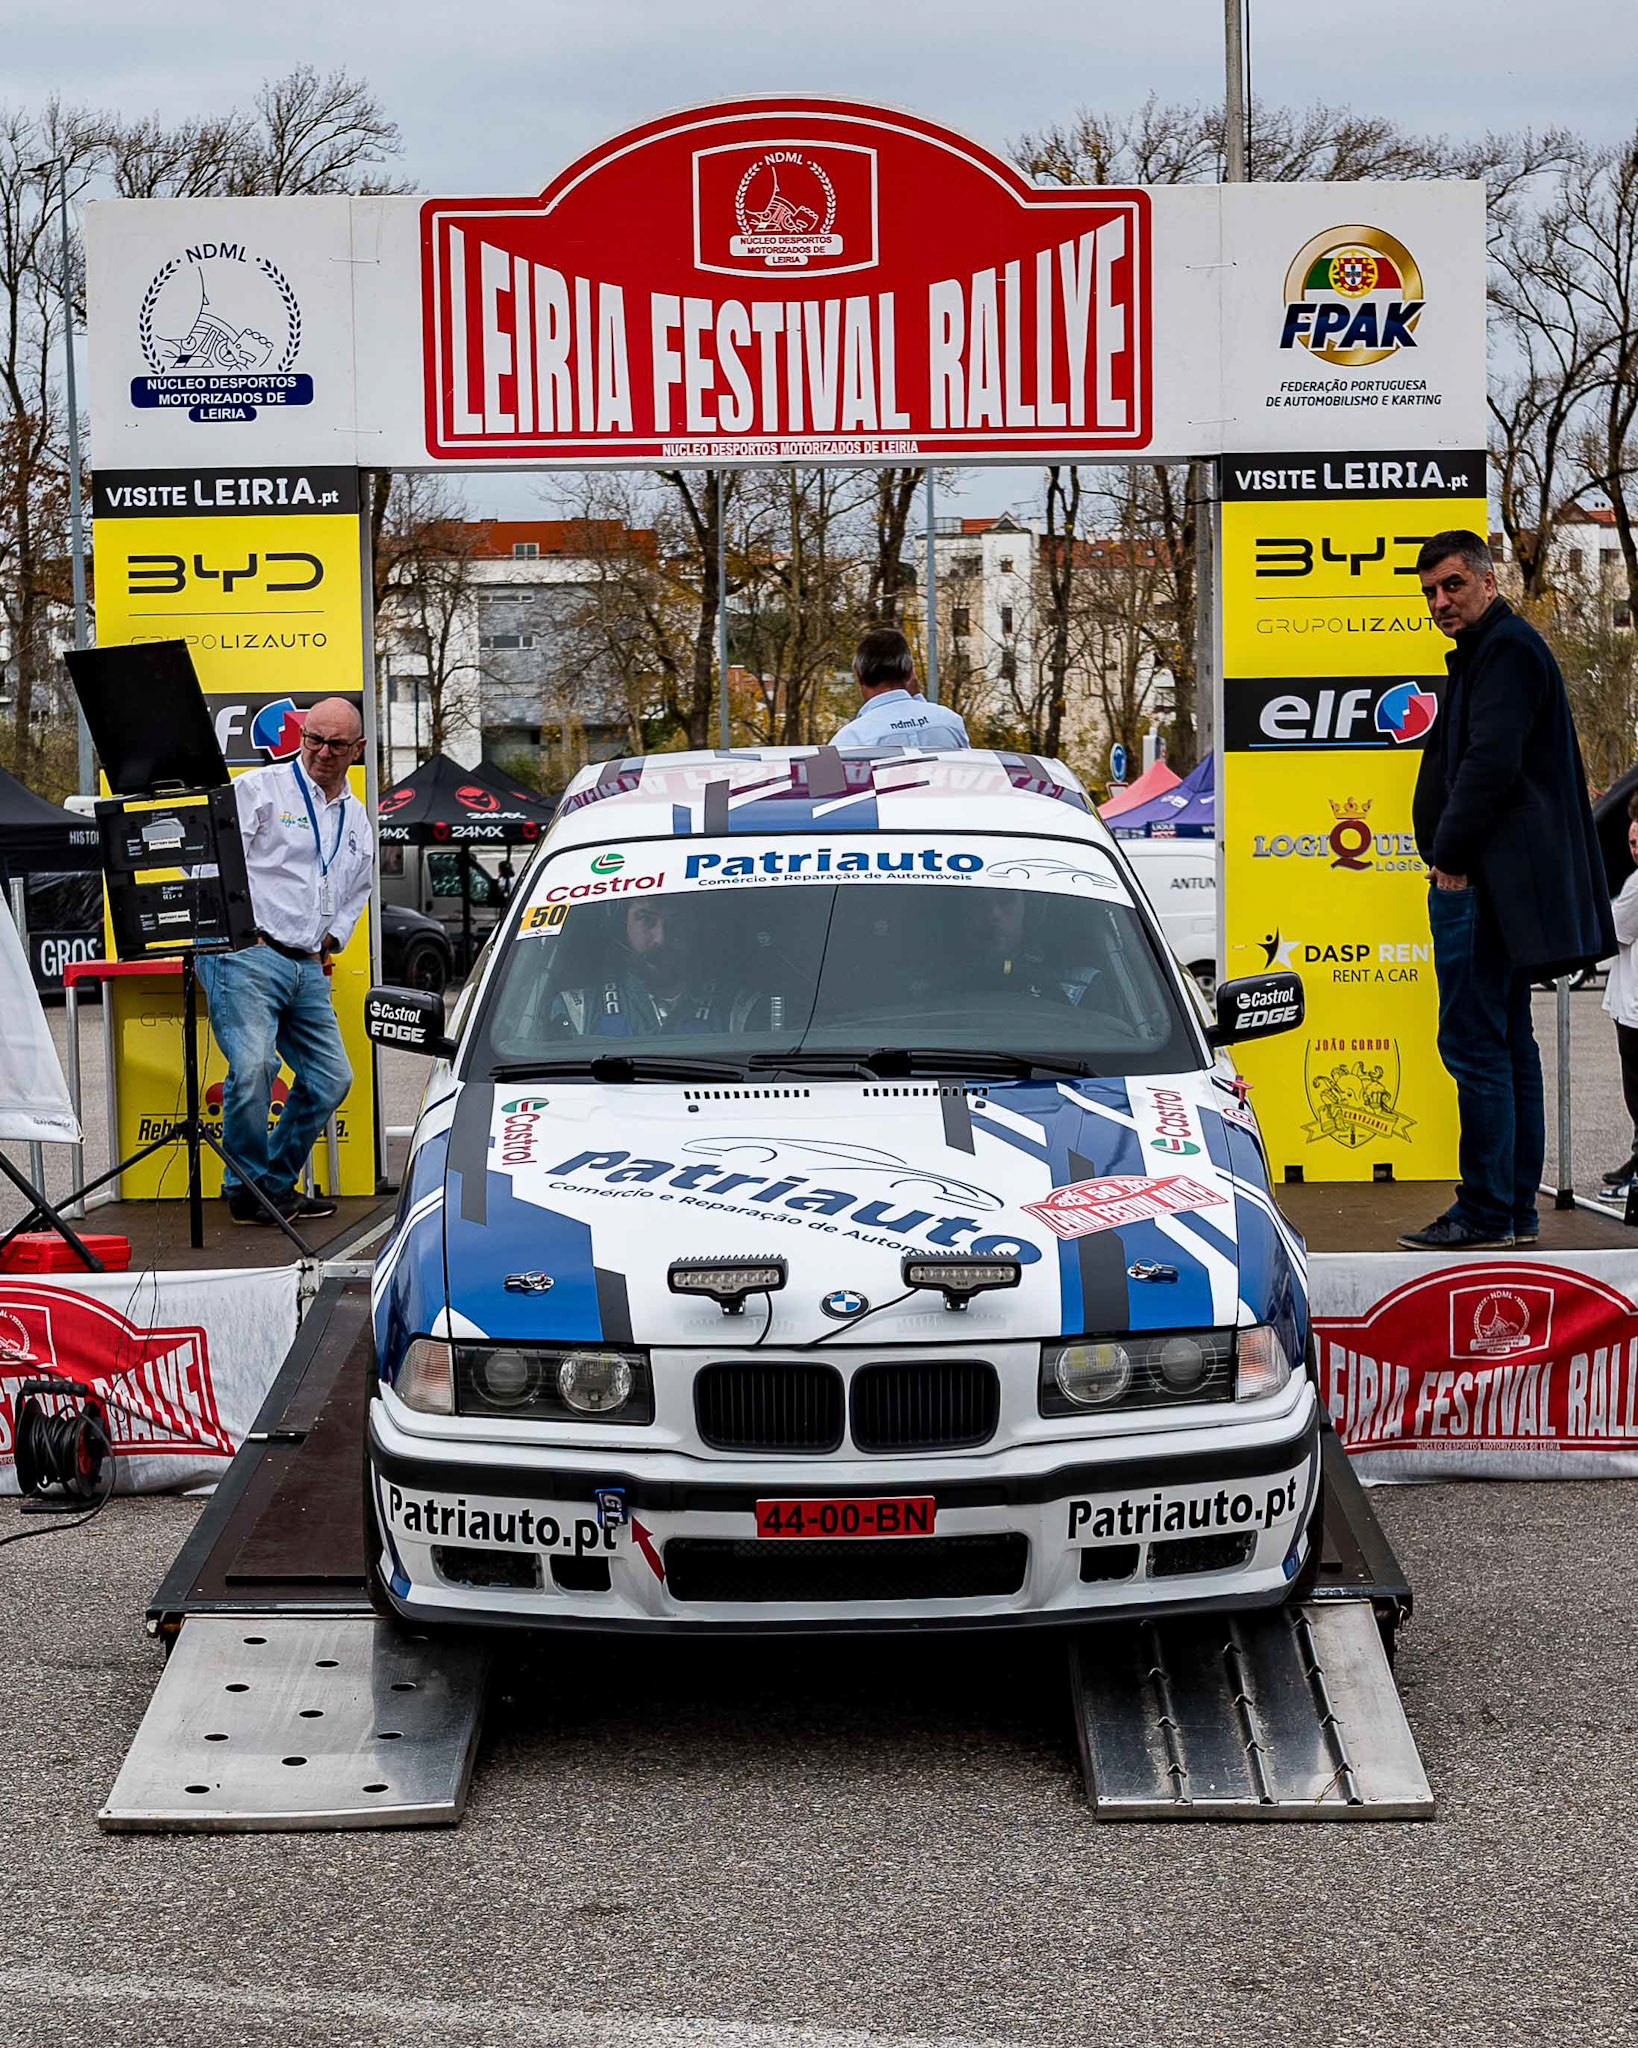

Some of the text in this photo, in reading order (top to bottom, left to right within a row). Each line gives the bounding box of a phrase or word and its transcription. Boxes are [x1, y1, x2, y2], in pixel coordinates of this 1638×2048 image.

[764, 152, 803, 165] NDML
[747, 246, 812, 254] MOTORIZADOS
[779, 235, 832, 244] DESPORTOS
[185, 242, 247, 263] NDML
[450, 214, 1127, 435] LEIRIA FESTIVAL RALLYE
[1279, 301, 1427, 350] FPAK
[147, 376, 297, 390] NÚCLEO DESPORTOS
[1280, 379, 1427, 393] FEDERAÇÃO PORTUGUESA
[158, 392, 286, 405] MOTORIZADOS DE
[1266, 394, 1442, 407] DE AUTOMOBILISMO E KARTING
[200, 408, 246, 420] LEIRIA
[711, 443, 777, 456] DESPORTOS
[781, 441, 861, 454] MOTORIZADOS
[864, 441, 879, 453] DE
[882, 440, 918, 453] LEIRIA
[1235, 469, 1316, 491] VISITE
[105, 486, 186, 507] VISITE
[128, 552, 324, 594] BYD
[890, 716, 930, 729] ndml.pt
[1260, 689, 1372, 739] elf
[1253, 820, 1419, 870] LOGIQUE
[685, 848, 984, 879] Patriauto
[546, 872, 665, 902] Castrol
[698, 874, 767, 886] Comércio
[784, 872, 859, 882] Reparação
[887, 872, 972, 881] Automóveis
[531, 905, 567, 928] 50
[1305, 943, 1435, 962] DASP REN
[1333, 968, 1419, 982] RENT A CAR
[1250, 987, 1294, 1007] Castrol
[381, 1003, 421, 1023] Castrol
[1235, 1005, 1299, 1029] EDGE
[371, 1021, 426, 1043] EDGE
[1351, 1038, 1389, 1051] GORDO
[1146, 1087, 1191, 1137] Castrol
[1343, 1110, 1388, 1132] CERVEJARIA
[503, 1113, 540, 1165] Castrol
[1085, 1184, 1123, 1200] 50
[544, 1150, 1043, 1265] Patriauto
[549, 1181, 655, 1198] Comércio
[679, 1196, 802, 1224] Reparação
[808, 1221, 838, 1233] de
[1040, 1178, 1214, 1234] LEIRIA FESTIVAL RALLYE
[1490, 1290, 1513, 1300] NDML
[1414, 1361, 1556, 1436] FESTIVAL
[763, 1501, 928, 1534] 44-00-BN
[1068, 1476, 1297, 1540] Patriauto.pt
[389, 1484, 618, 1556] Patriauto.pt
